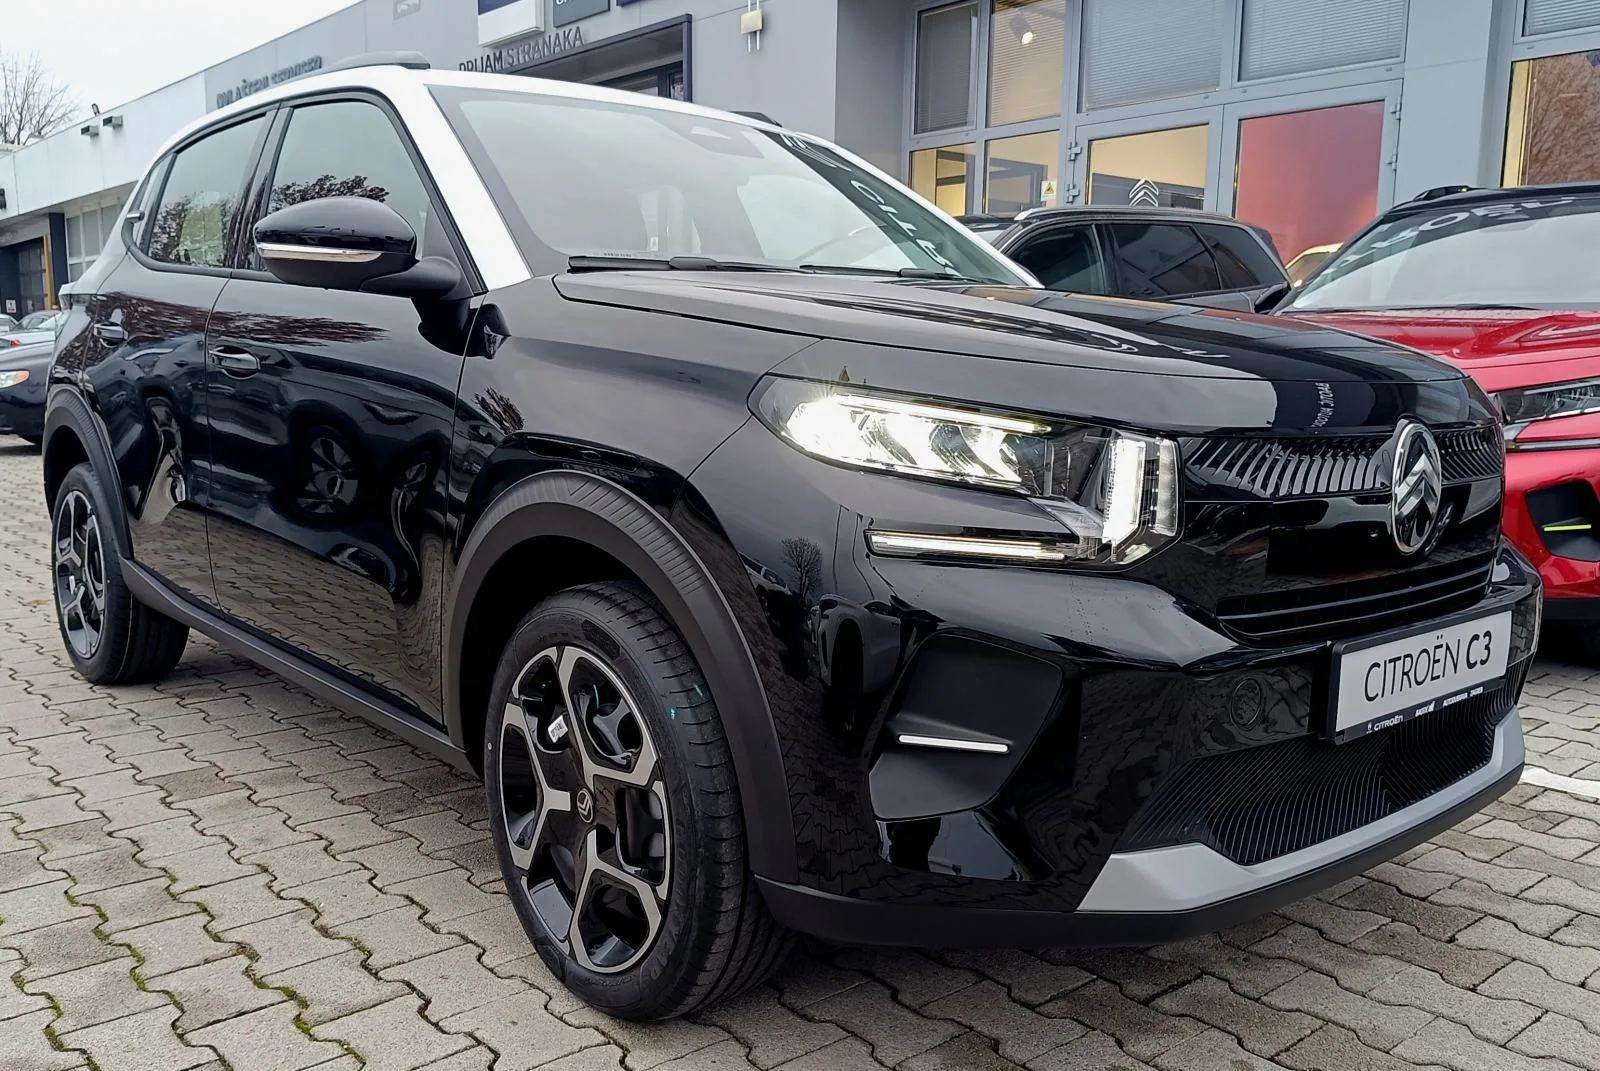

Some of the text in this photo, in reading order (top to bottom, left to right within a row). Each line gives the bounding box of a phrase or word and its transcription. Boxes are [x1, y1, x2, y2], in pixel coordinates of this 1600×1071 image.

[506, 26, 584, 67] STRANAKA
[1364, 630, 1492, 702] CITROËN C3
